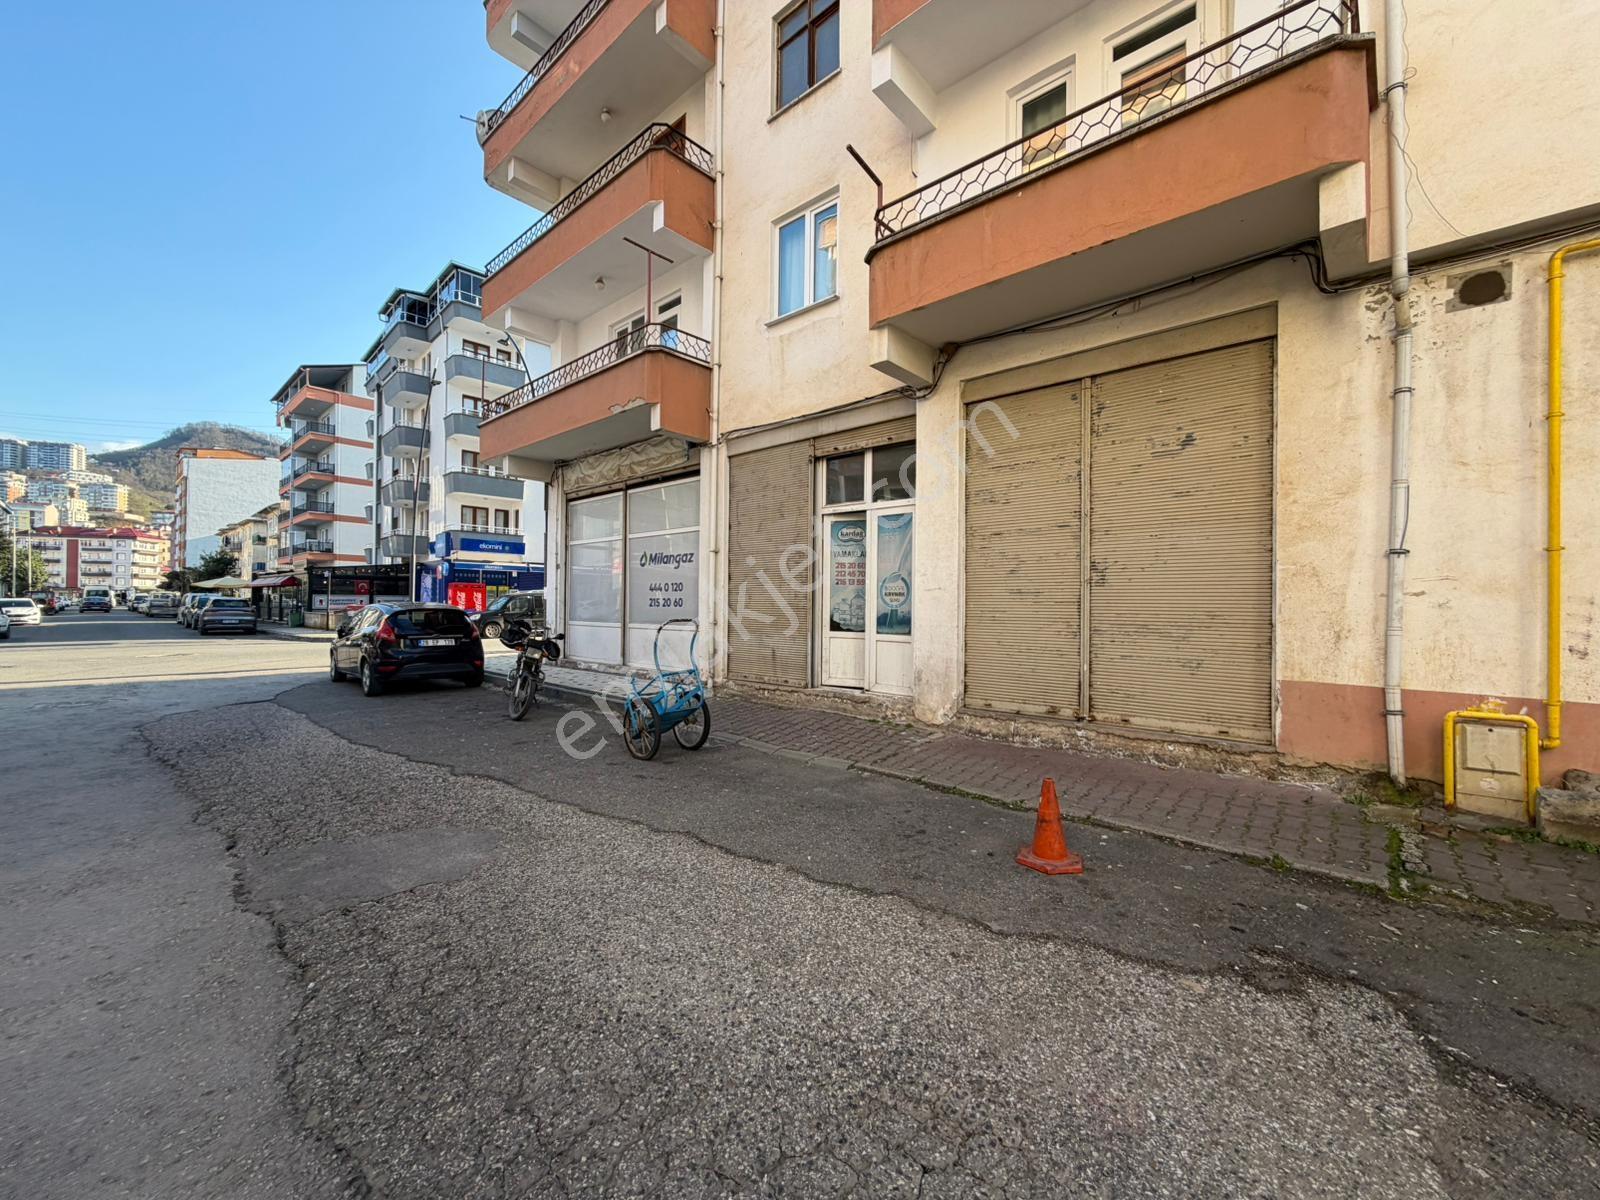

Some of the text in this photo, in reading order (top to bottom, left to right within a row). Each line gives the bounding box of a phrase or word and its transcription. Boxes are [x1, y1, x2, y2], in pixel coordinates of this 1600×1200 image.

[479, 541, 503, 551] ekomini
[833, 550, 866, 558] YAMAKLA
[649, 552, 695, 569] Milangaz
[649, 582, 684, 592] 444 0 120
[649, 597, 684, 607] 215 20 60
